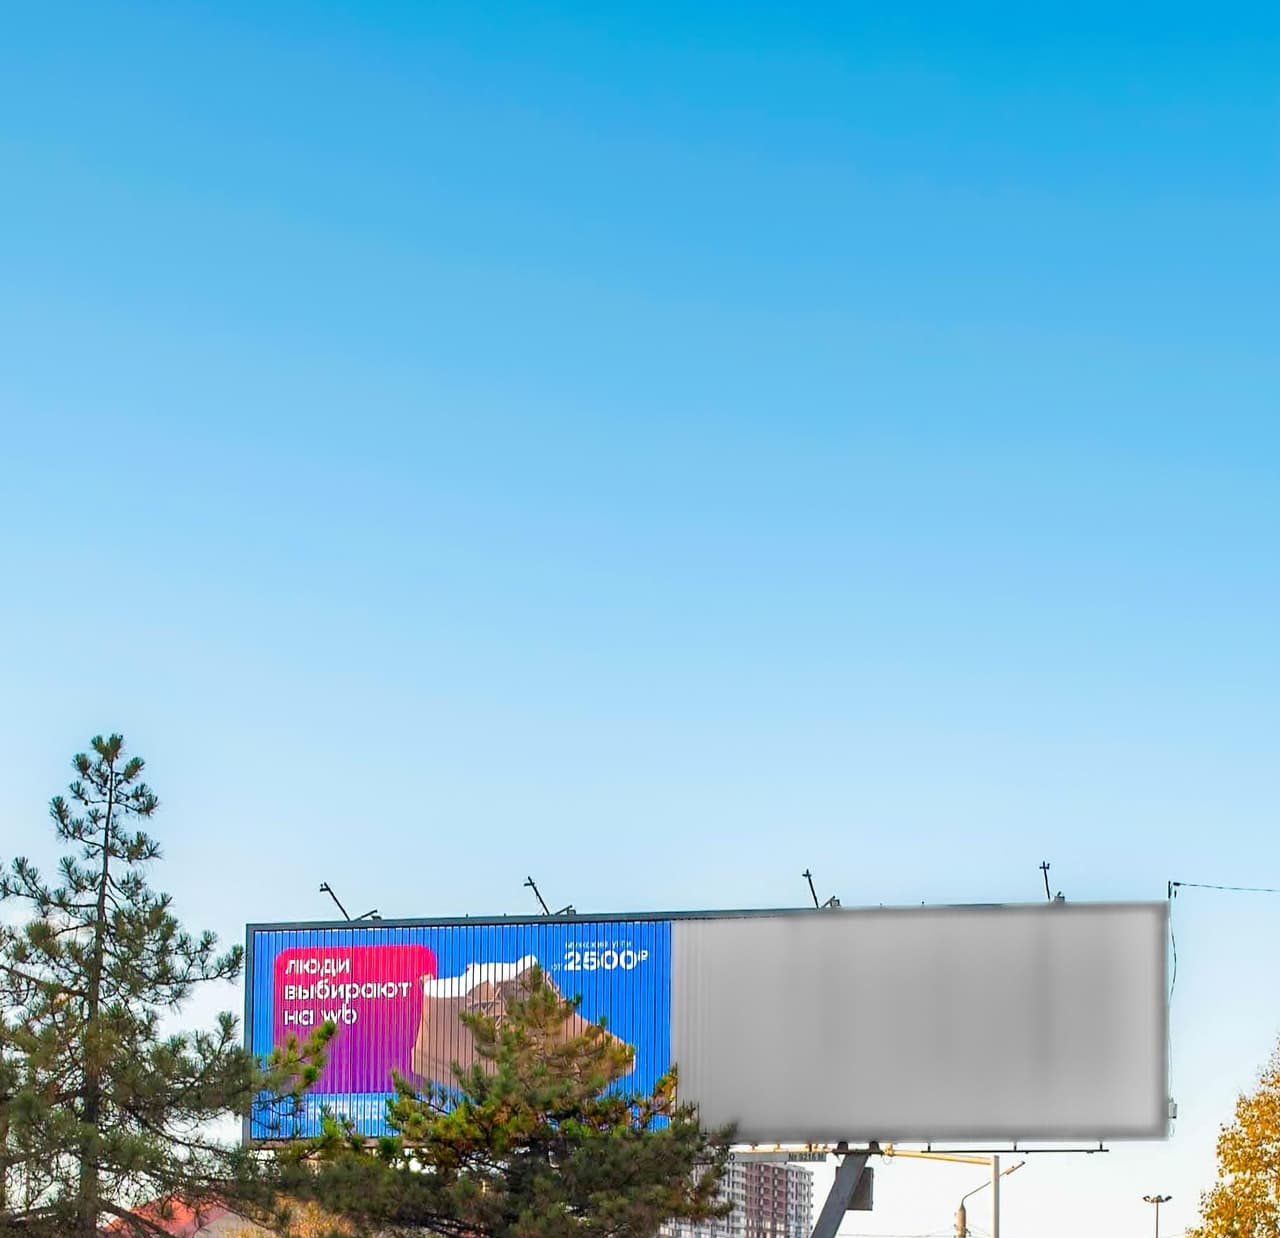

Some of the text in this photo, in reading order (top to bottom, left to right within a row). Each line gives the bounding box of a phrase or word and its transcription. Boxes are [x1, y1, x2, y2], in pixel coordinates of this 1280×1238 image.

[285, 958, 350, 977] люди
[284, 979, 412, 1004] выбирают
[284, 1009, 314, 1026] на
